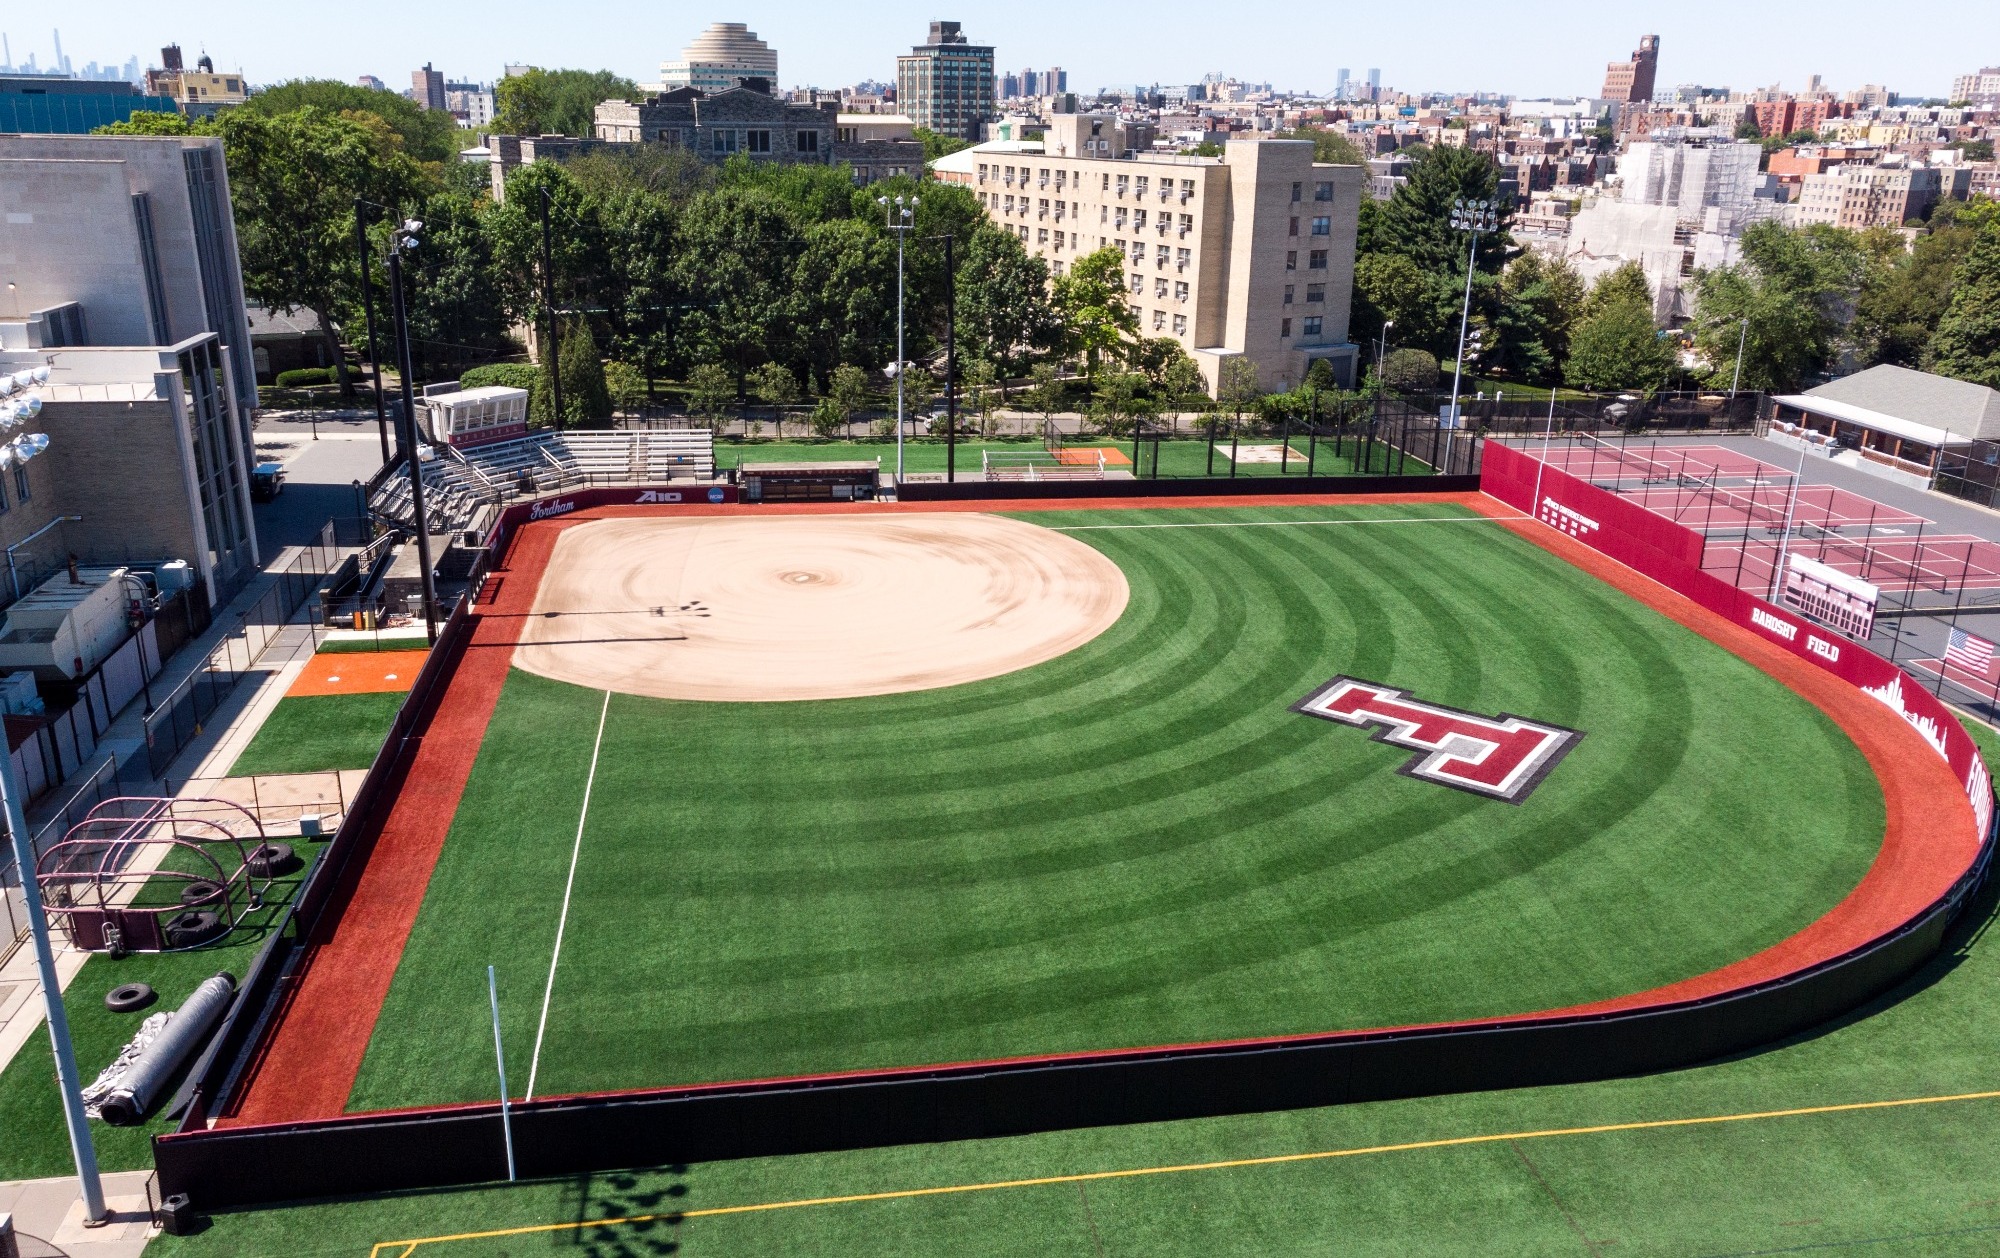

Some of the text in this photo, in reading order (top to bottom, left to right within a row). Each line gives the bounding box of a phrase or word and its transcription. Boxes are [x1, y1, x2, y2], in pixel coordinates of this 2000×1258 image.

[635, 490, 682, 502] A10
[530, 499, 574, 520] Fordham
[1752, 607, 1840, 662] BAHOSHY FIELD
